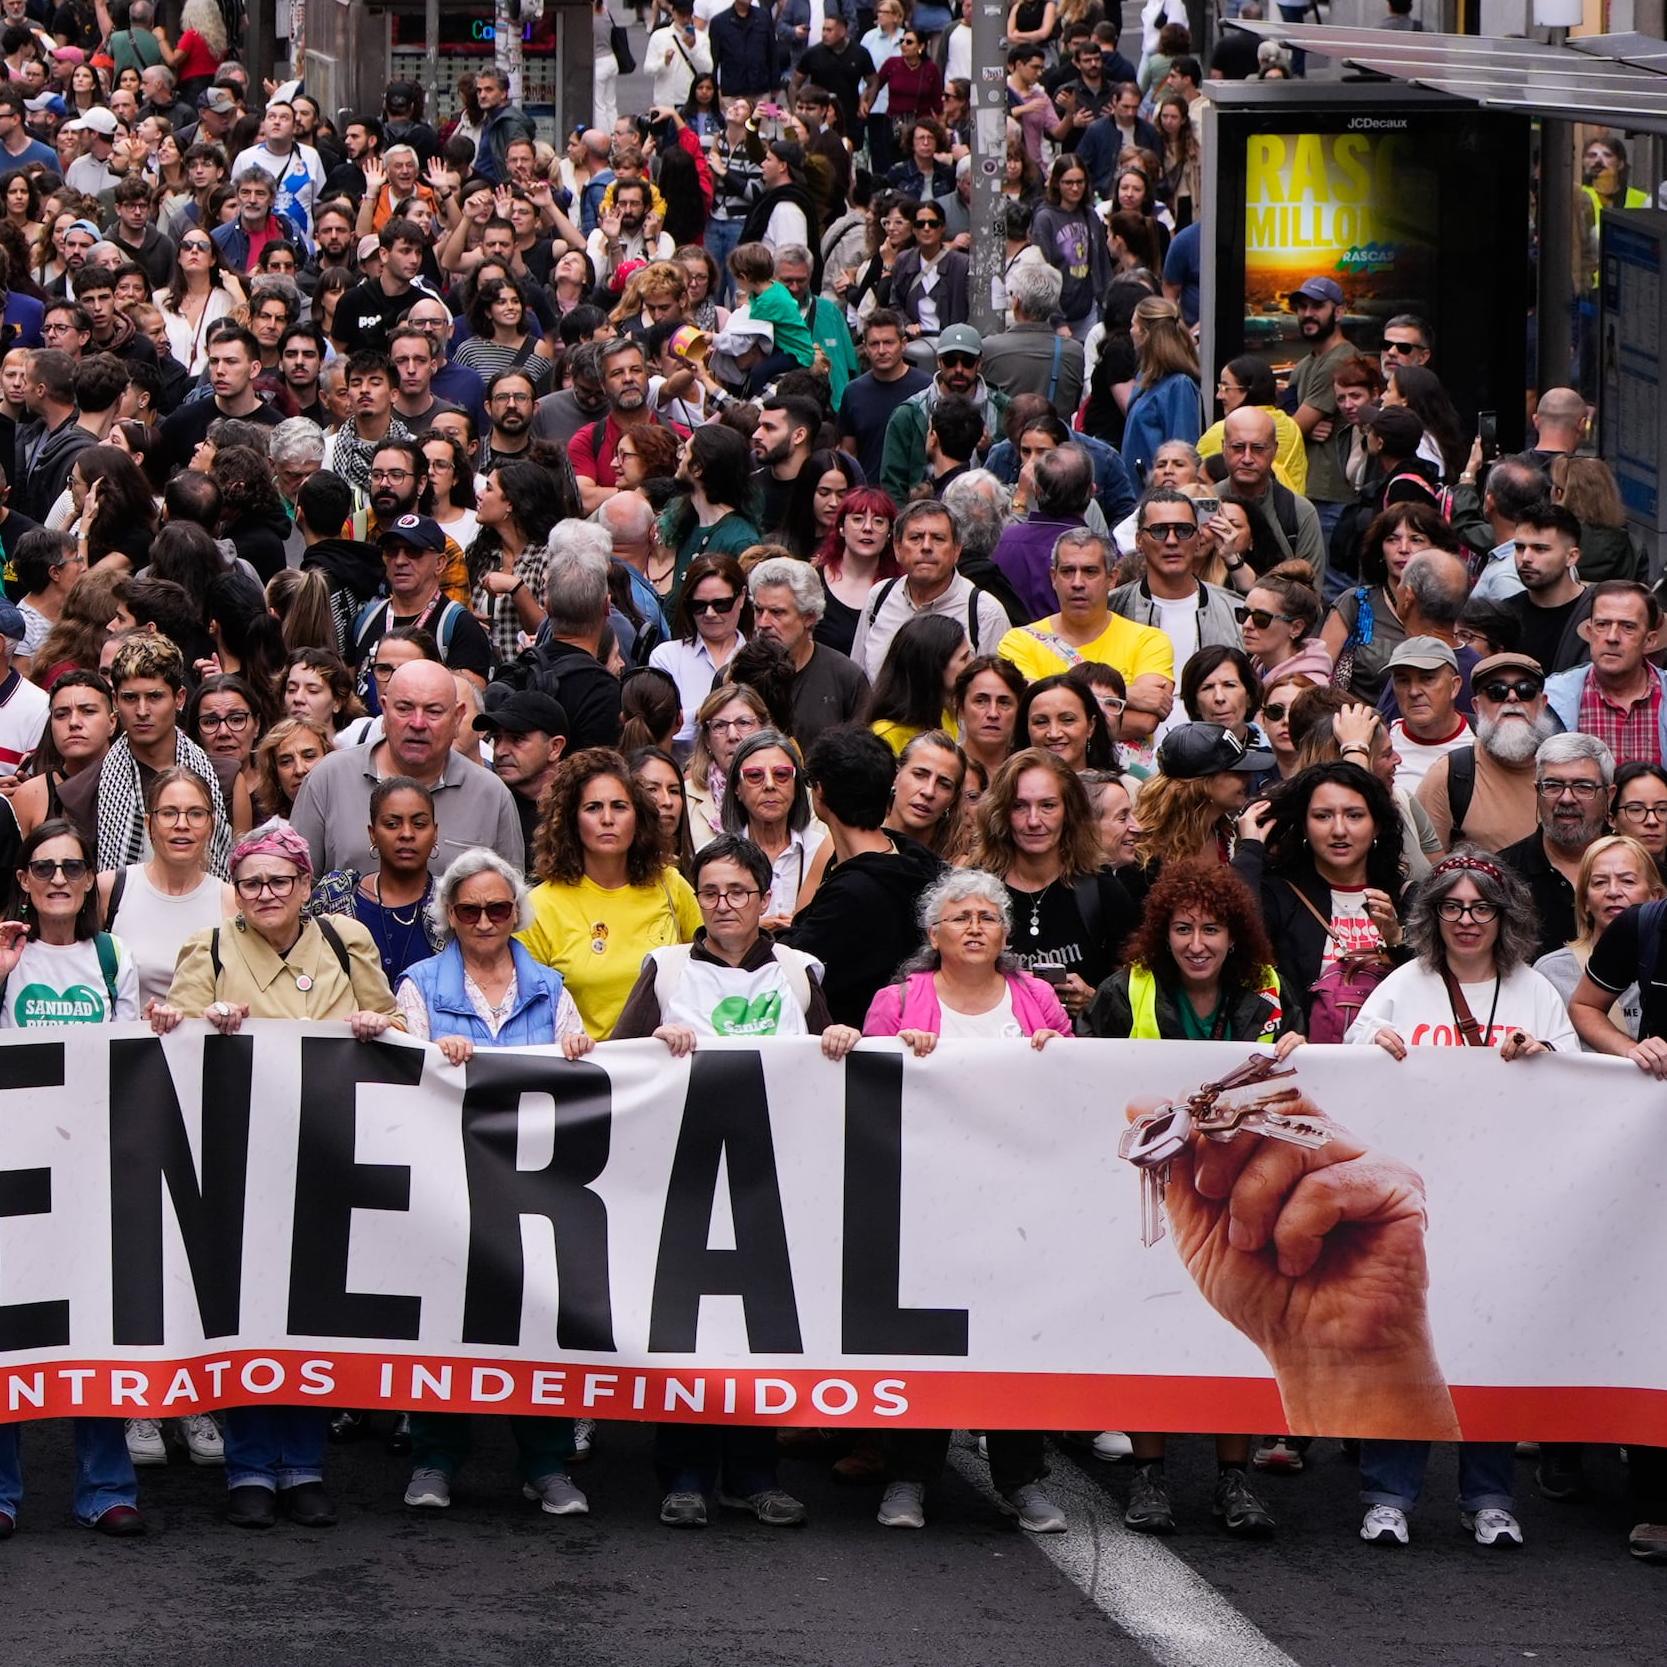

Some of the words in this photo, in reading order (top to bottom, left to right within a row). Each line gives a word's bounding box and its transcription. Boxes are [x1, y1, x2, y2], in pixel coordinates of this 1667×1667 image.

[1347, 118, 1408, 130] JCDecaux
[26, 999, 93, 1017] SANIDAD
[1623, 1007, 1639, 1018] ME
[379, 1361, 910, 1417] INDEFINIDOS
